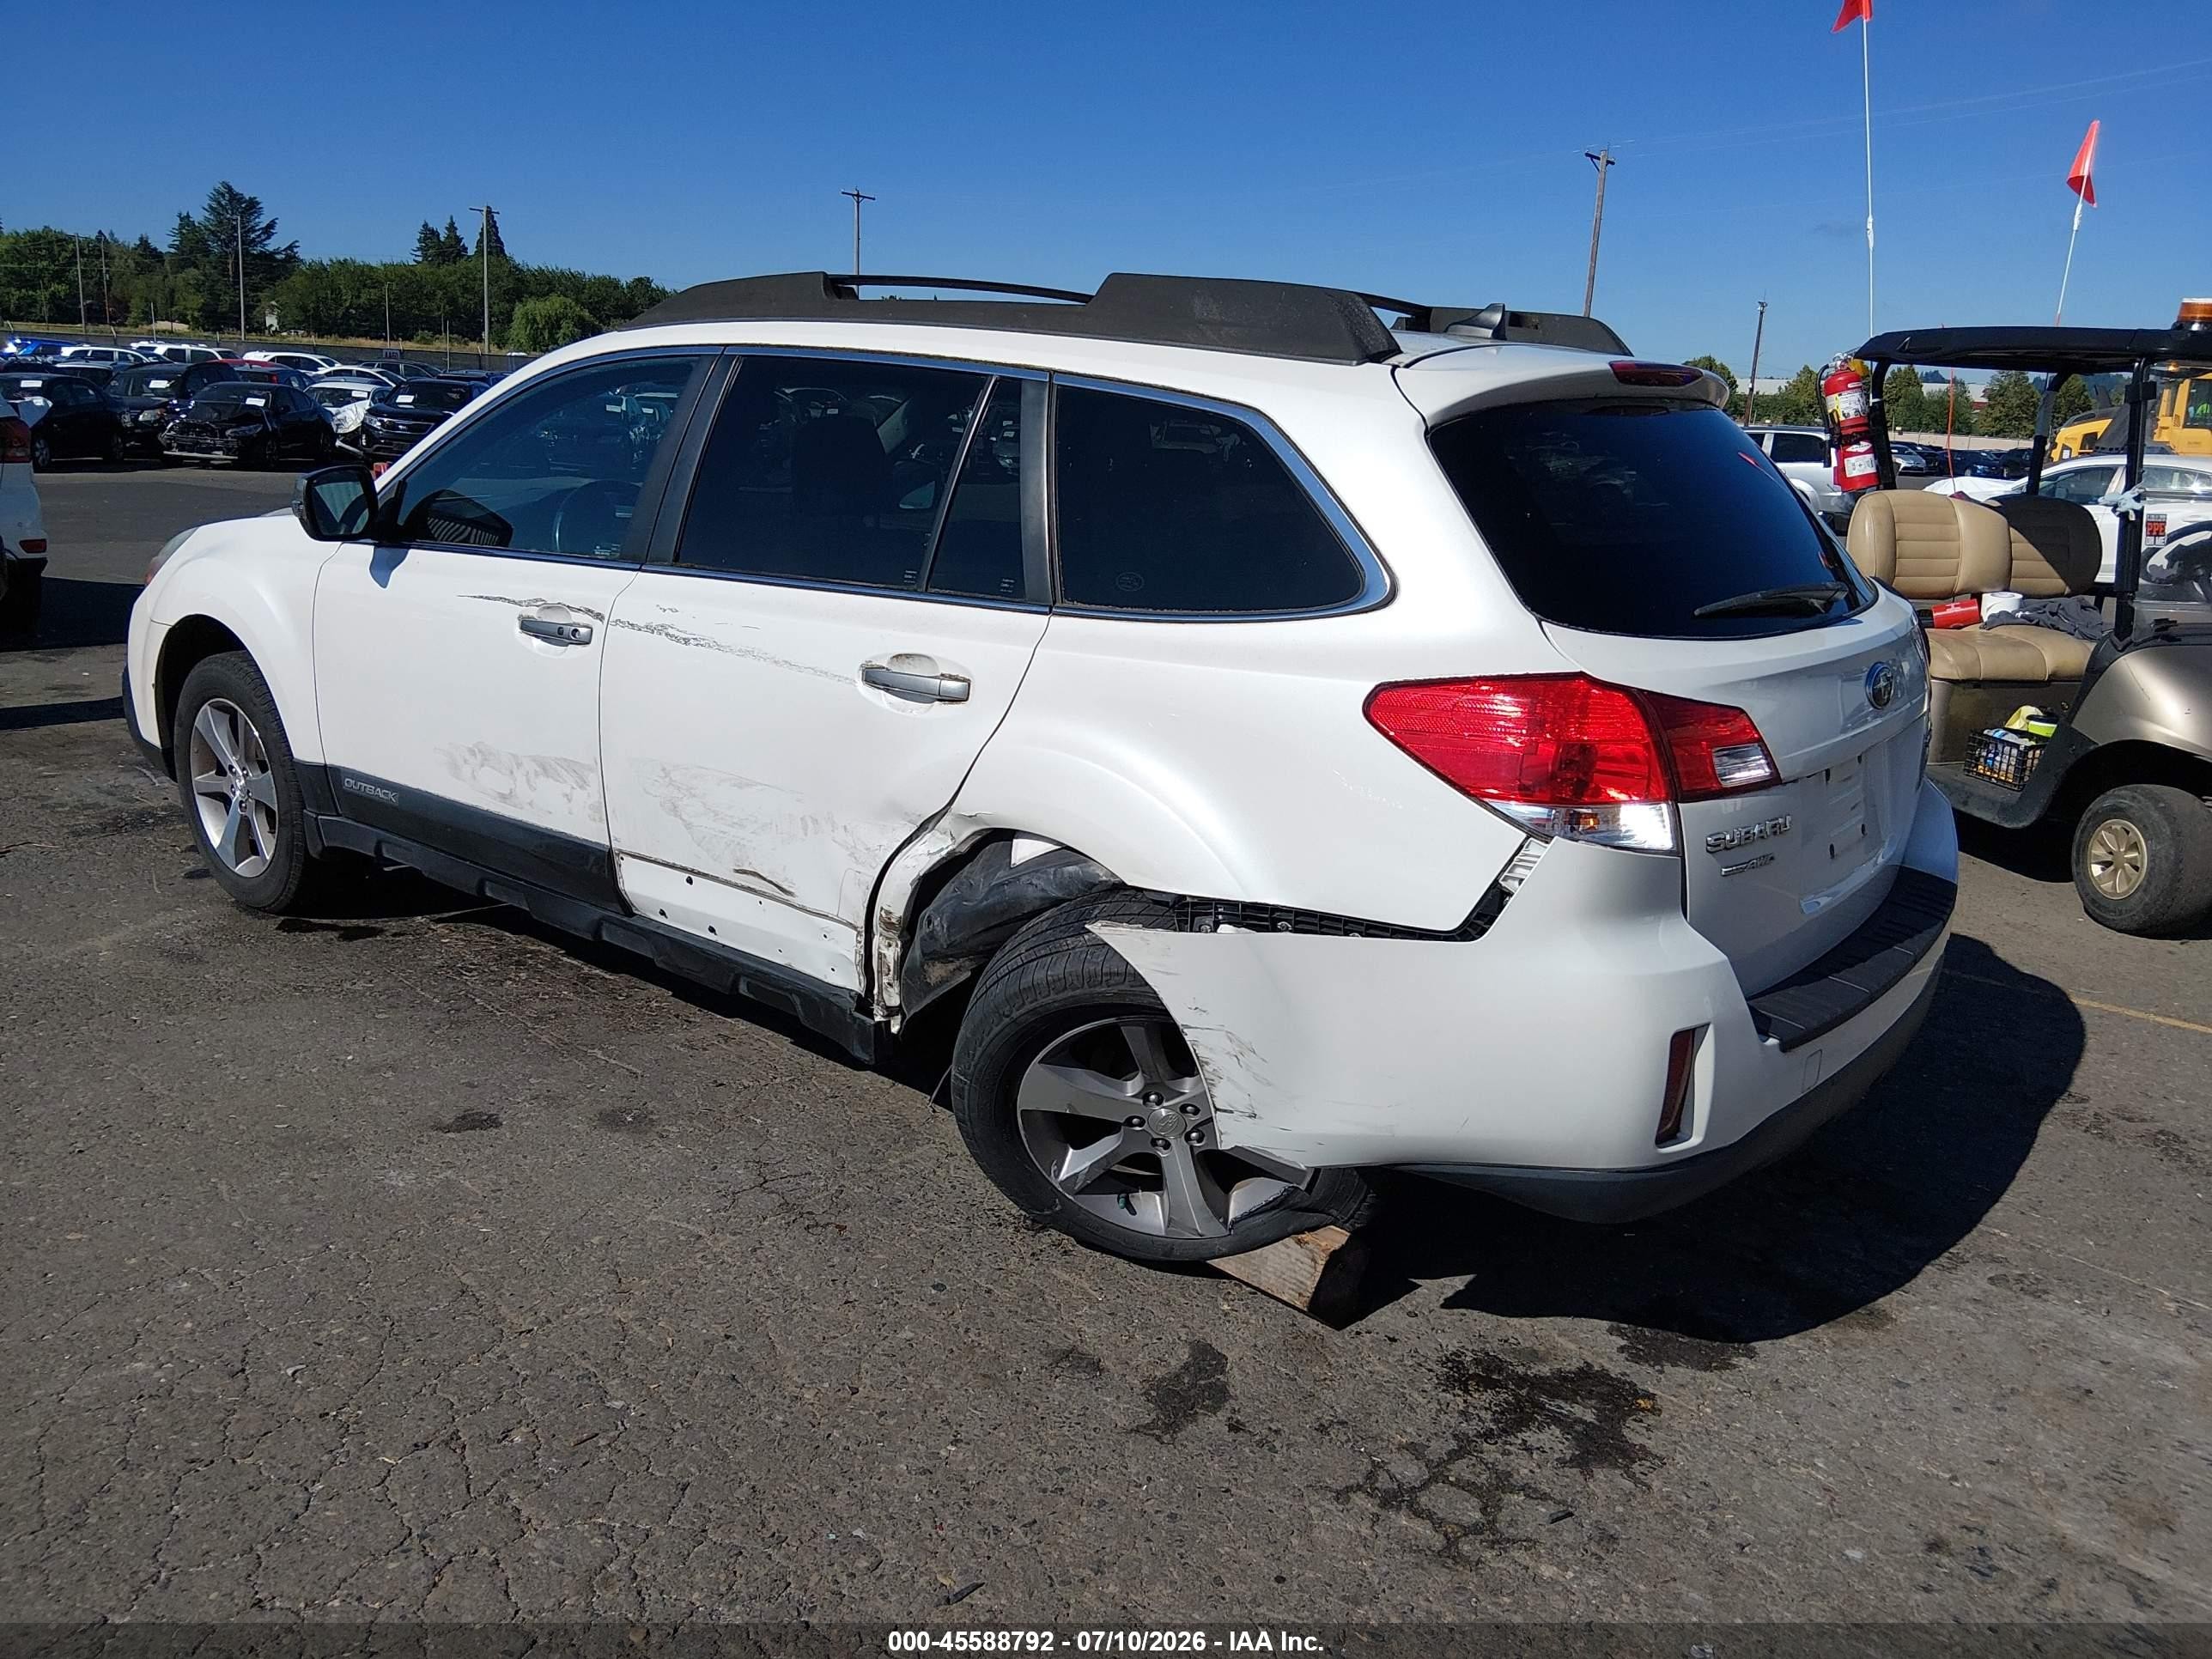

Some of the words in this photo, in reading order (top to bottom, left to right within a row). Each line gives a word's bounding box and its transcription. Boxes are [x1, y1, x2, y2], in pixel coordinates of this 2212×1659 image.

[2147, 522, 2166, 535] PPE
[344, 778, 398, 803] OUTBACK
[1706, 815, 1792, 853] SUBARU
